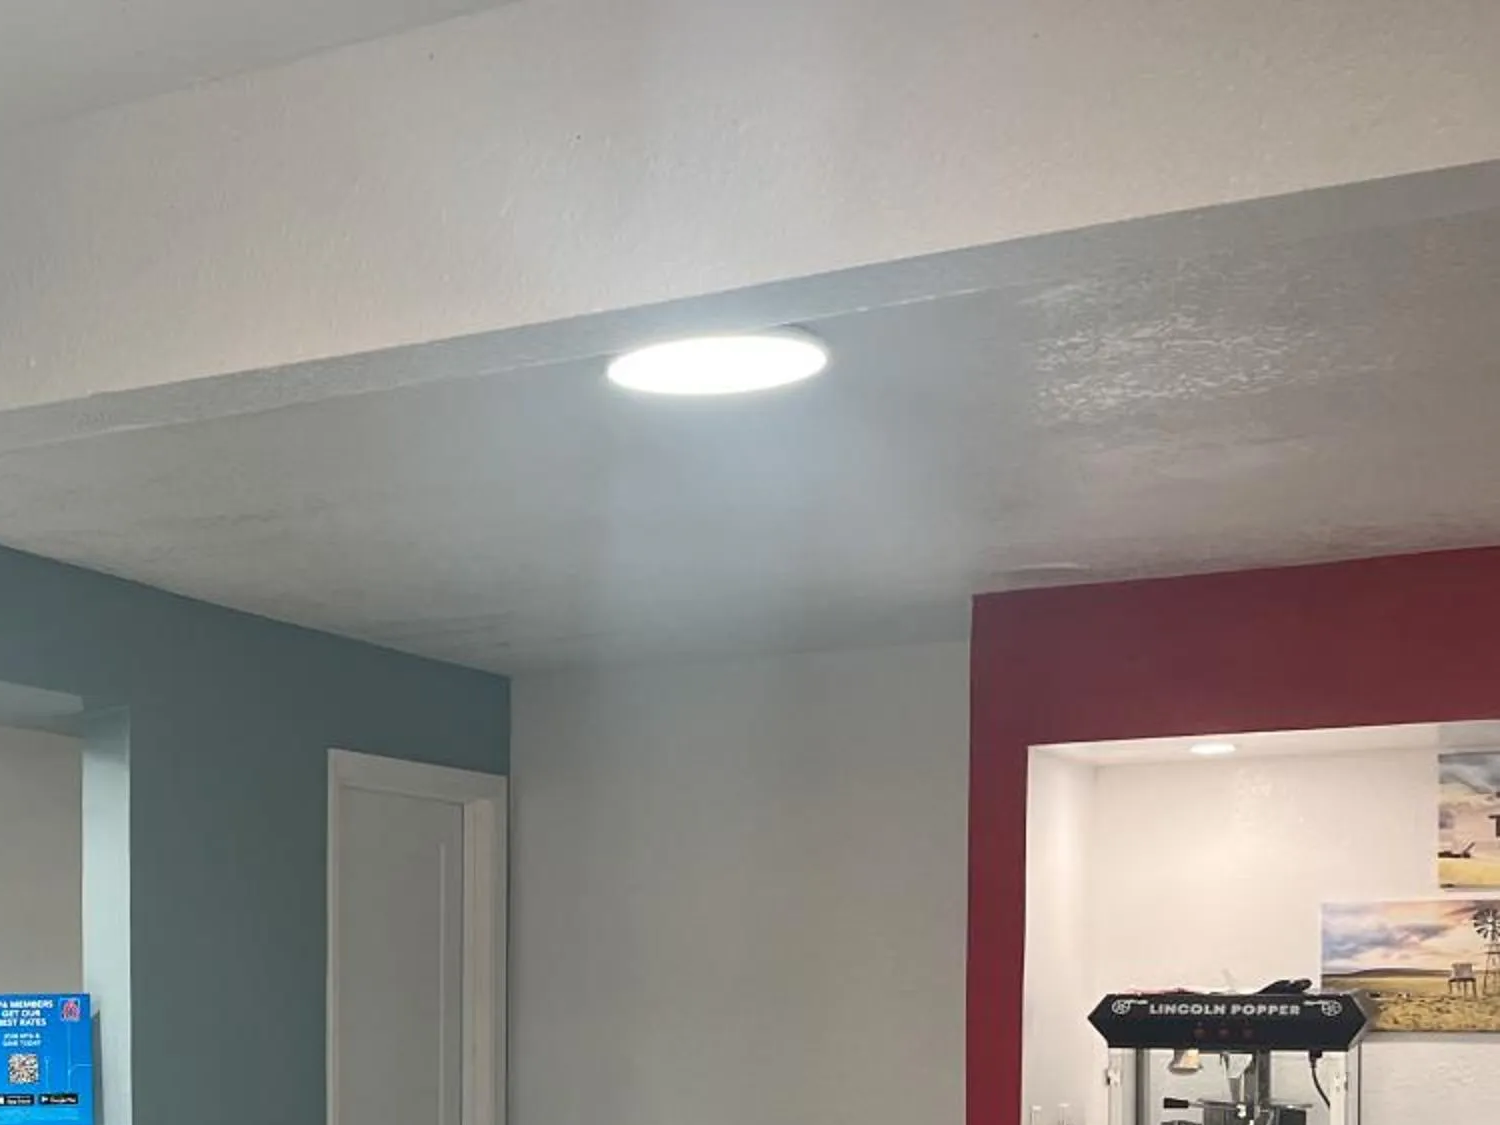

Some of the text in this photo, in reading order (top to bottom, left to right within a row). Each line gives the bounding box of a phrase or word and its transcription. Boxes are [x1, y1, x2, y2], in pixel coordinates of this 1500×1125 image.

[10, 999, 53, 1008] MEMBERS
[1, 1009, 41, 1018] GET OUR
[1150, 1004, 1300, 1016] LINCOLN POPPER
[19, 1018, 47, 1027] RATES
